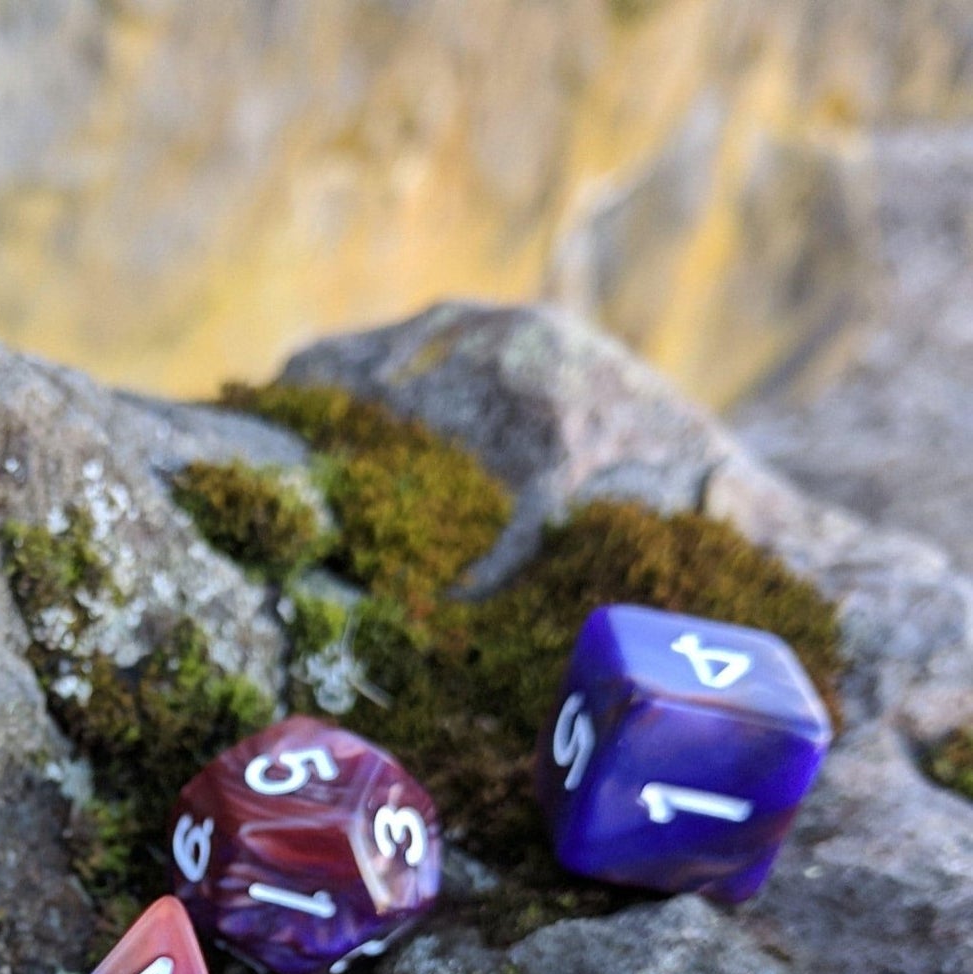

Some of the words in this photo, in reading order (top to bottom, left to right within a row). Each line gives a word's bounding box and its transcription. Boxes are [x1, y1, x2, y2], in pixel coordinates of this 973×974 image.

[671, 634, 751, 688] 4
[245, 748, 339, 795] 5
[639, 782, 753, 823] 1
[374, 805, 425, 867] 3
[248, 882, 336, 919] 1
